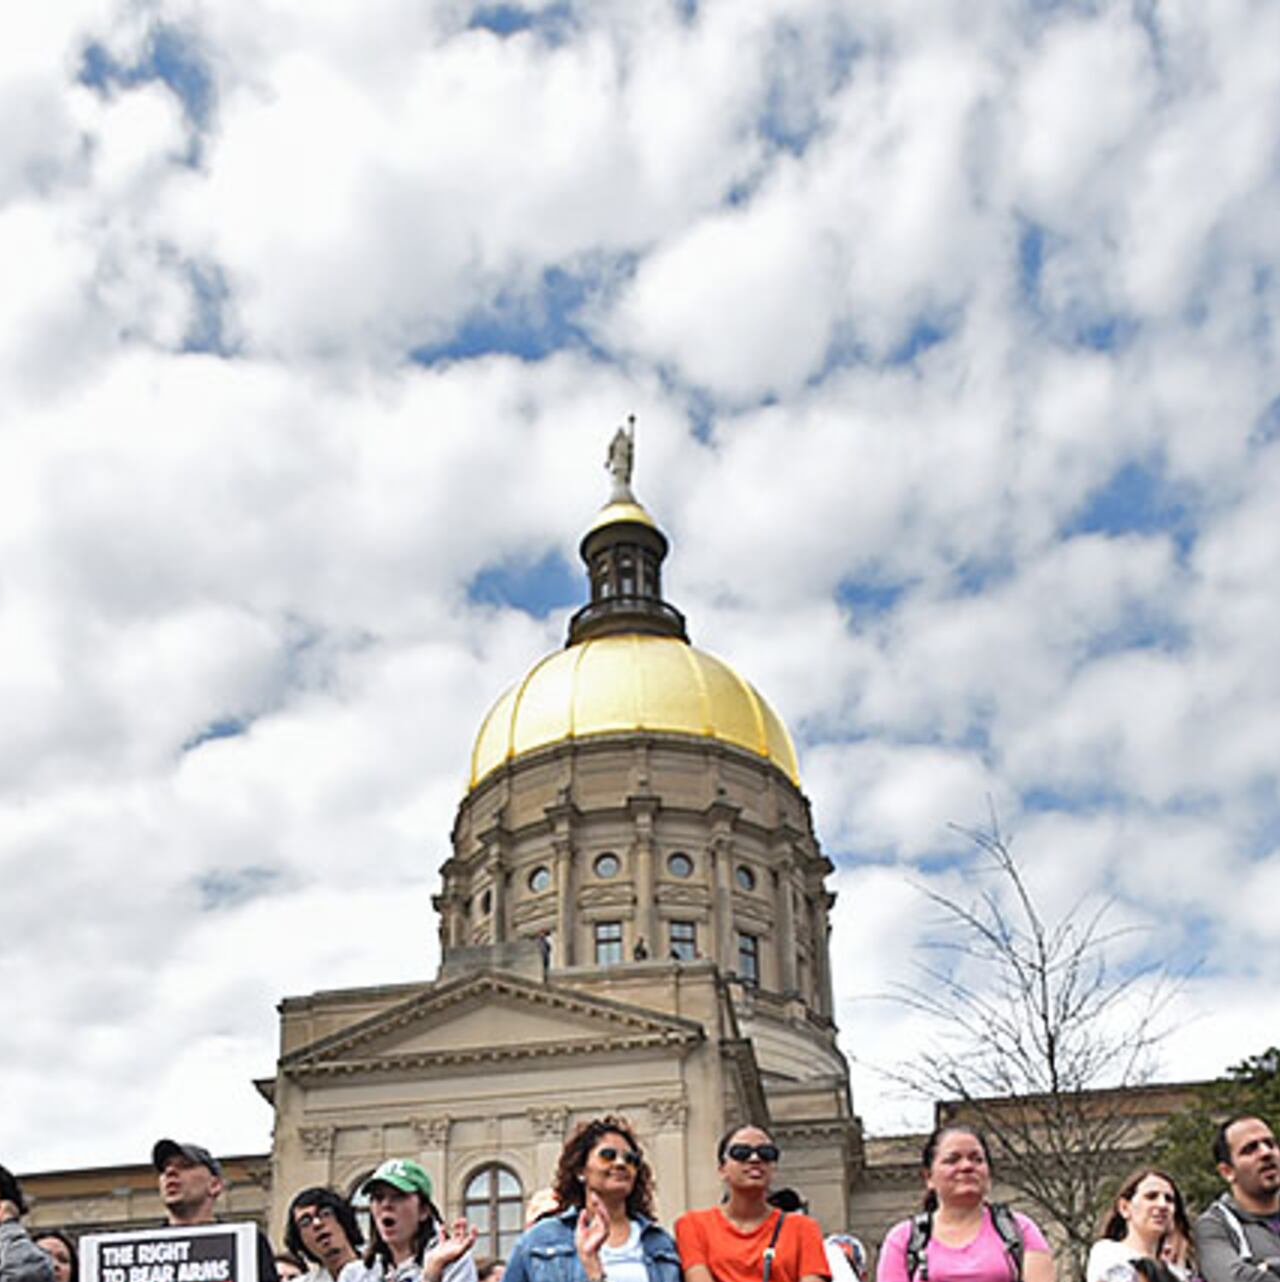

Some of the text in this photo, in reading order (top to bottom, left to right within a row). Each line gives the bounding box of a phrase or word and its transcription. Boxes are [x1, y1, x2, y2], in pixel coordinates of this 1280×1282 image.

[102, 1241, 190, 1266] THE RIGHT
[178, 1260, 229, 1282] ARMS
